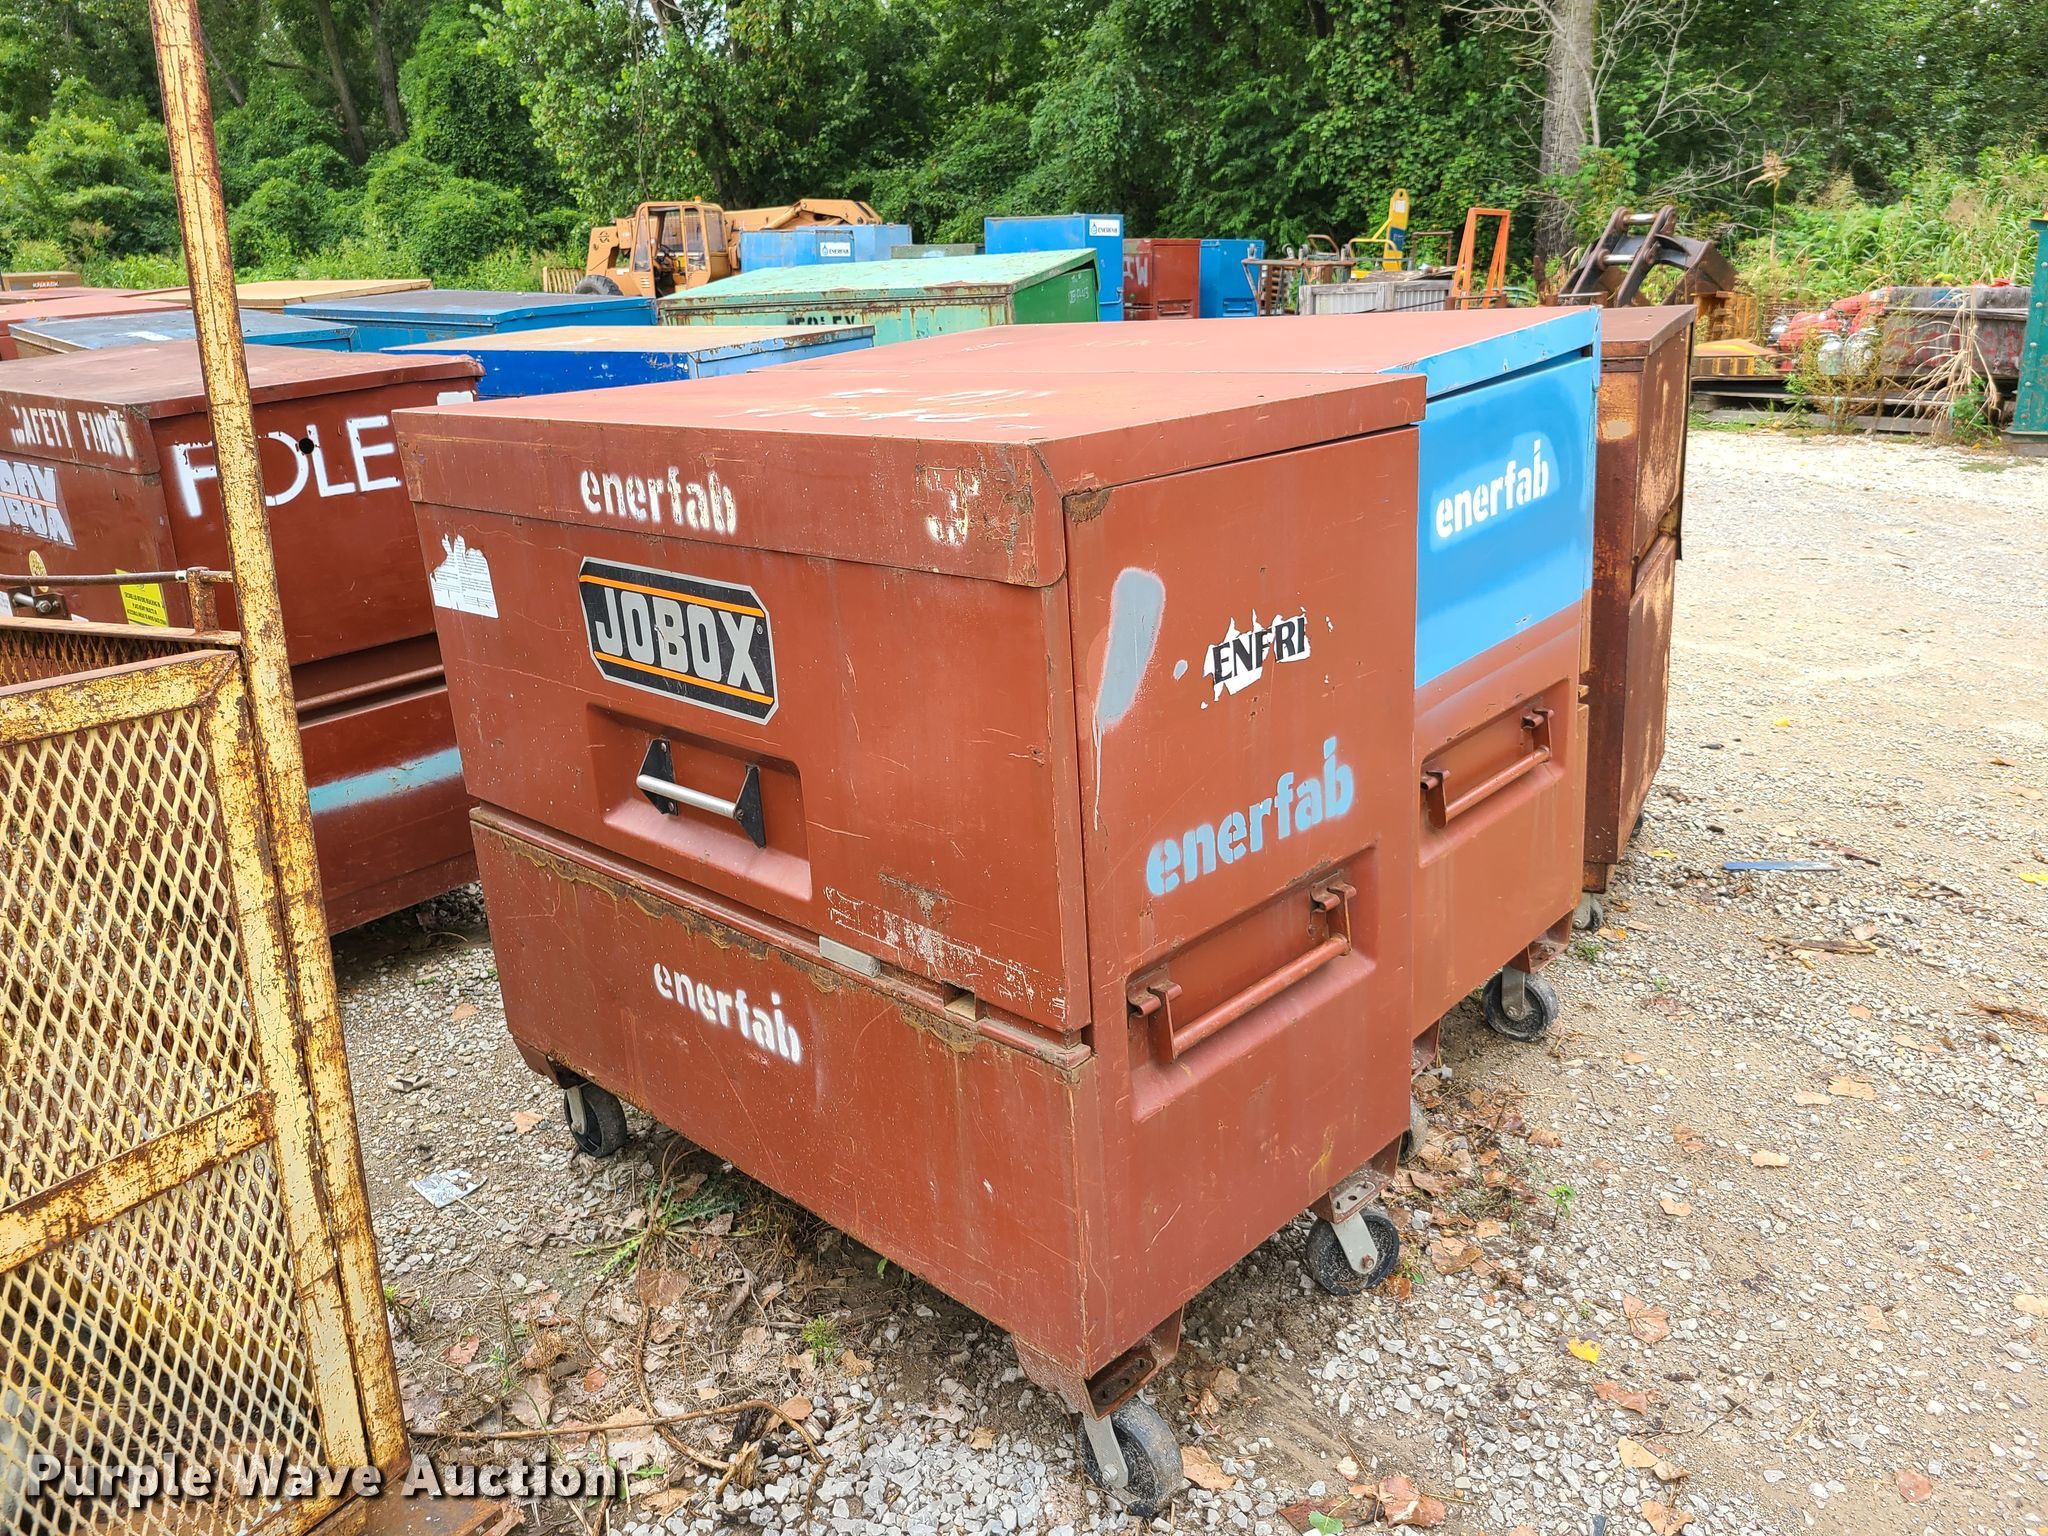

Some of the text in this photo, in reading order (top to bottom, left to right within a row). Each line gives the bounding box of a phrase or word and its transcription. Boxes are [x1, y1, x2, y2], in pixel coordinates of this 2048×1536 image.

[580, 466, 736, 534] enerfab
[1435, 438, 1549, 538] enerfab
[595, 587, 766, 694] JOBOX
[1145, 736, 1354, 896] enerfab
